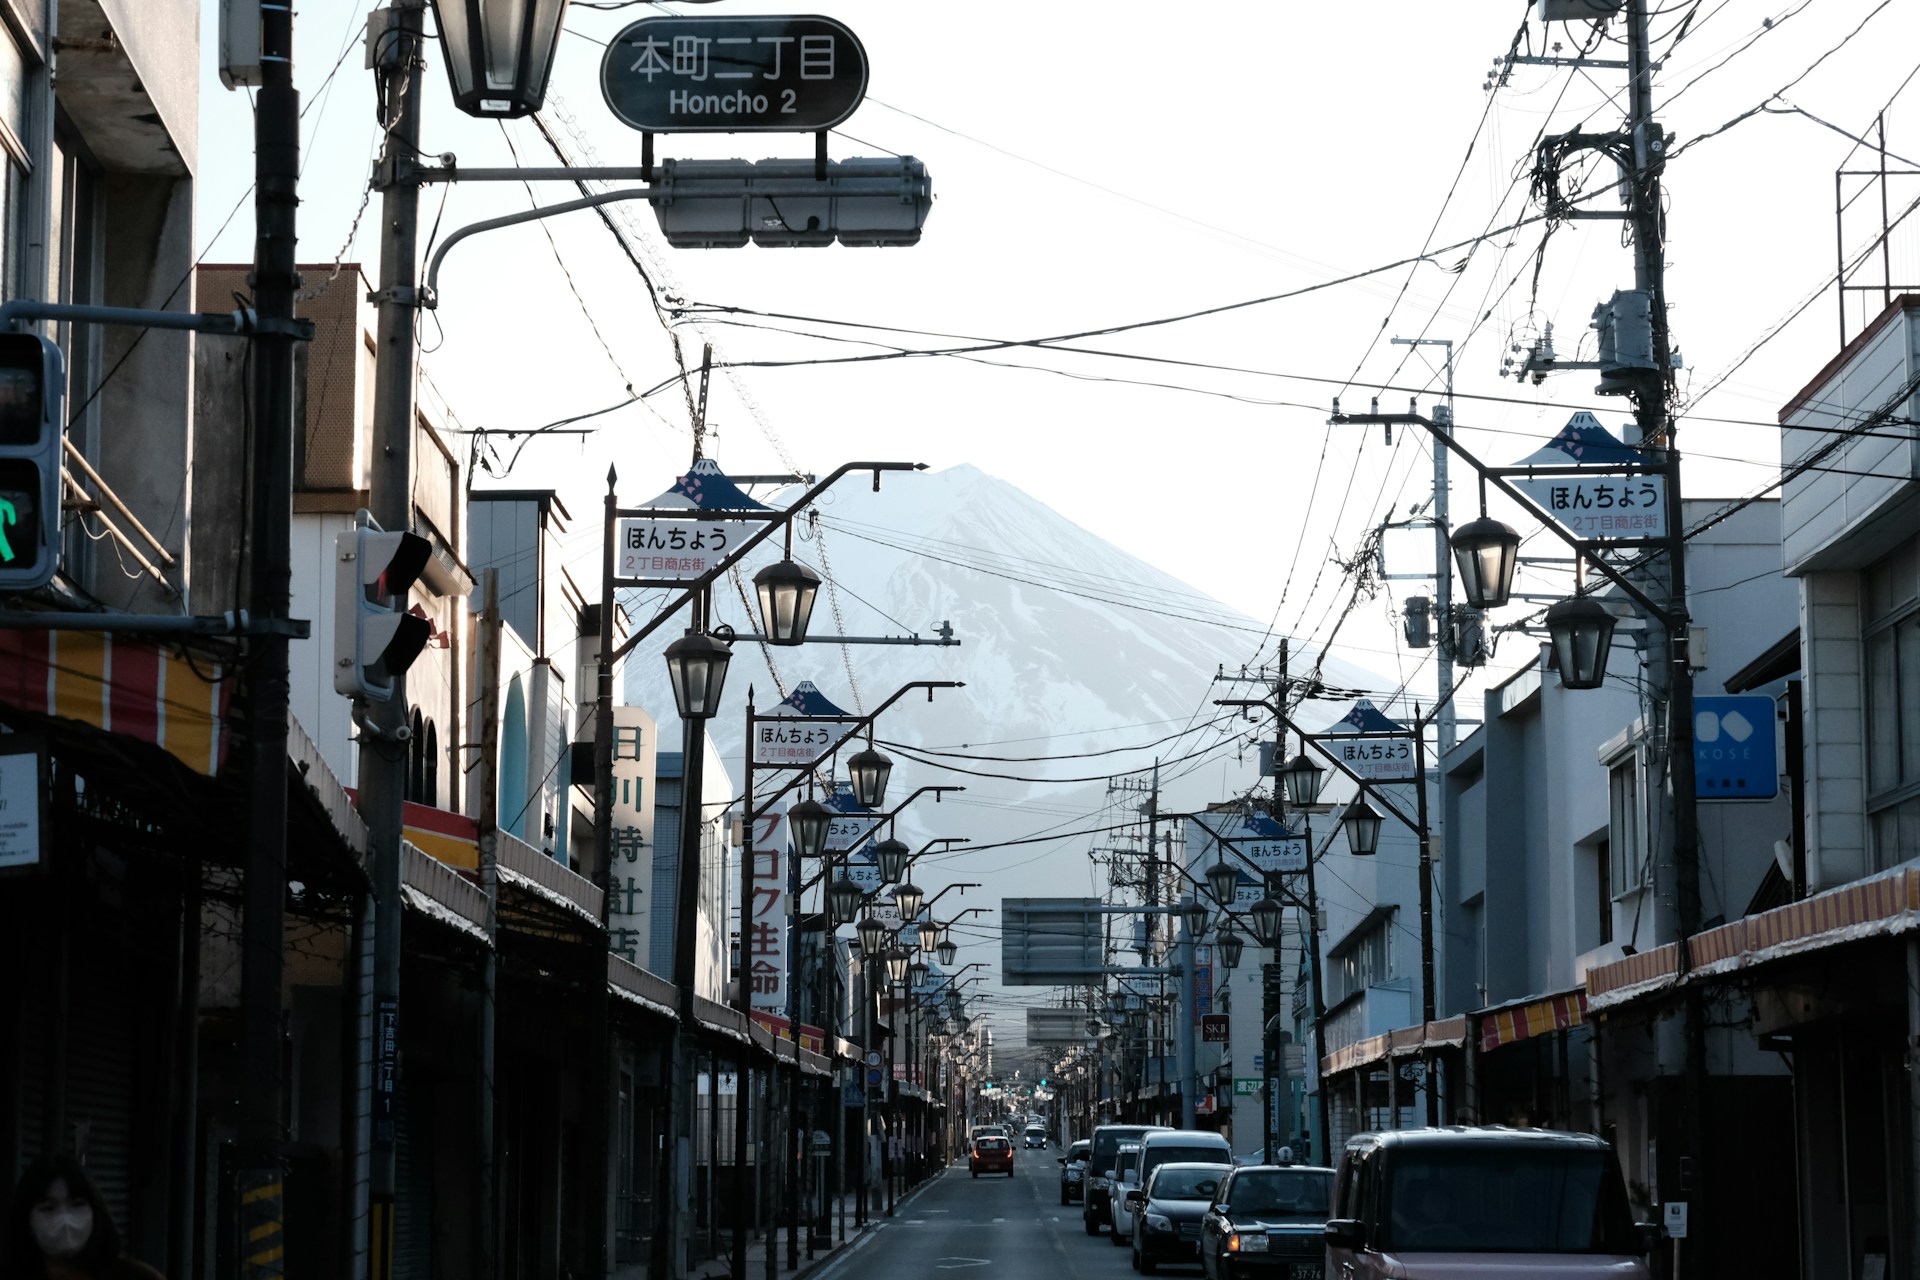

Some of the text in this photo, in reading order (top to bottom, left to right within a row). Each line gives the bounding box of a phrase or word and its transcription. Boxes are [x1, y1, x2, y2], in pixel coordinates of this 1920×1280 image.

[630, 34, 835, 83] 本町二丁目
[669, 88, 797, 114] Honcho 2
[1551, 483, 1657, 510] ほんちょう
[1572, 513, 1659, 531] 2丁目商店街
[627, 526, 727, 551] ほんちょう
[625, 555, 706, 571] 2丁目商店街
[761, 727, 829, 745] ほんちょう
[760, 746, 815, 758] 2丁目商店街
[1343, 743, 1409, 761] ほんちょう
[1357, 762, 1411, 773] 2丁目商店街
[1251, 843, 1303, 858] ほんちょう
[751, 812, 782, 995] フコク生命
[384, 1012, 396, 1093] 下吉田二丁目
